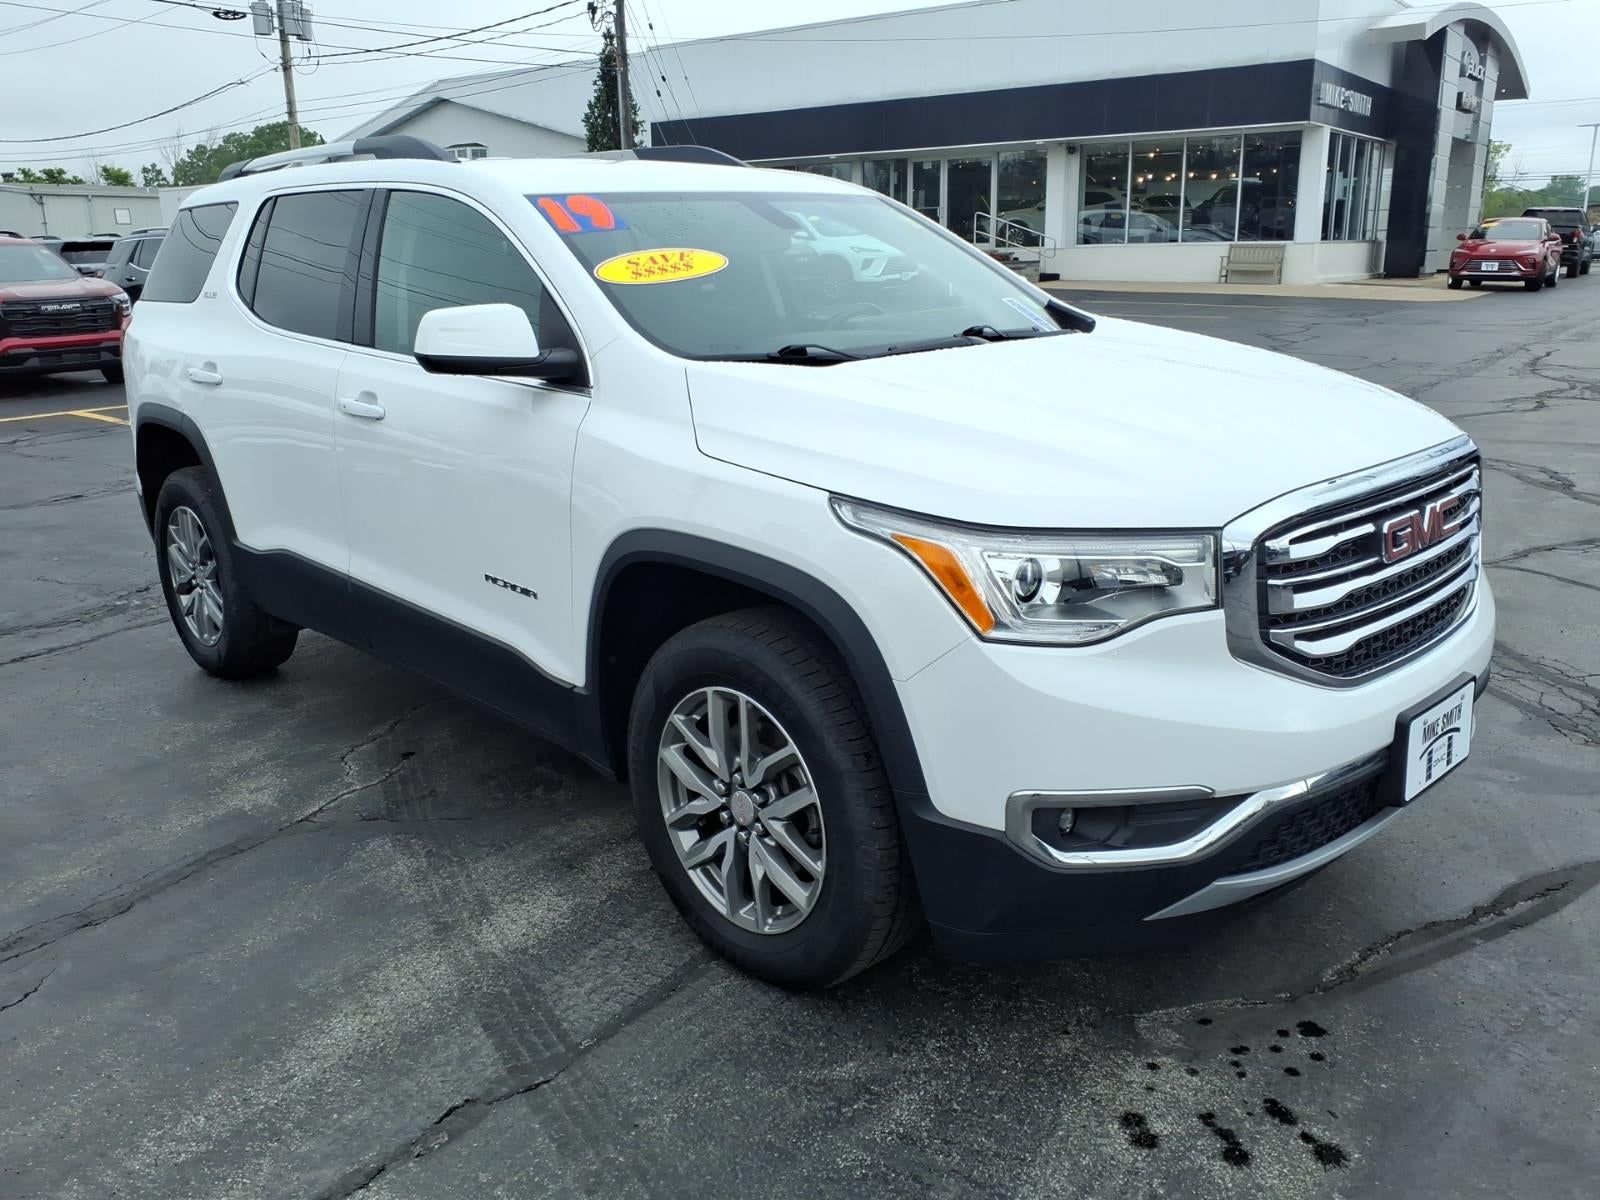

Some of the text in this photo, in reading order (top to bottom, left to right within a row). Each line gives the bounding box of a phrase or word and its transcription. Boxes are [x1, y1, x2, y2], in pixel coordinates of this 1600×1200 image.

[1320, 82, 1372, 117] MIKE SMITH
[538, 194, 616, 233] 19
[626, 251, 693, 270] SAVE
[1383, 494, 1460, 564] GMC
[1422, 702, 1463, 746] MIKE SMITH
